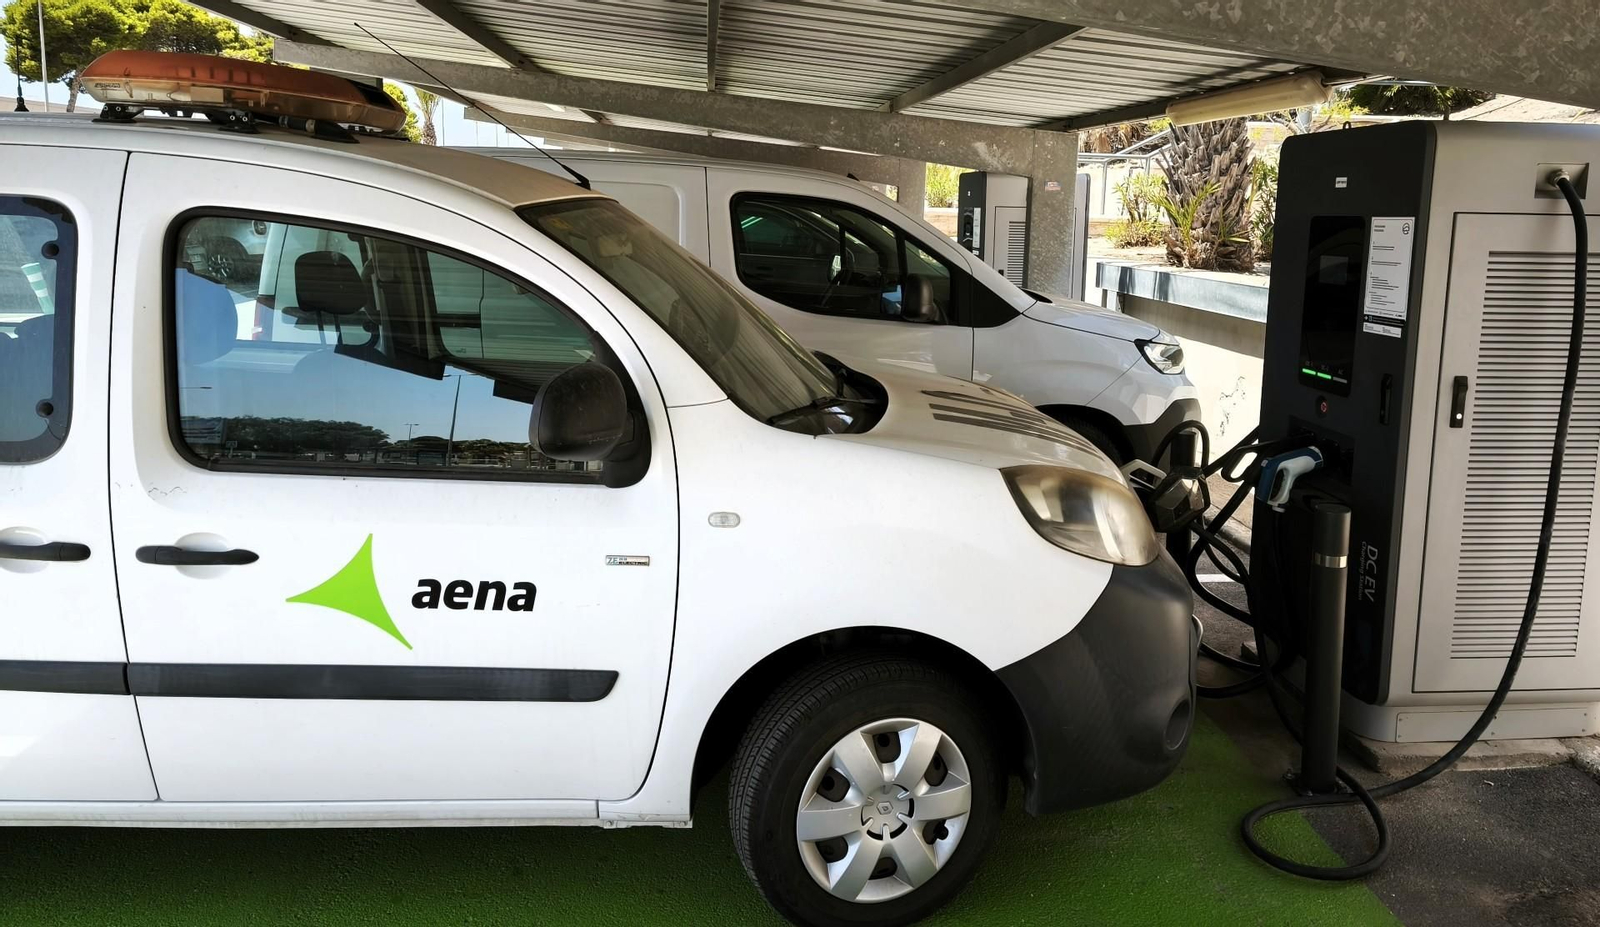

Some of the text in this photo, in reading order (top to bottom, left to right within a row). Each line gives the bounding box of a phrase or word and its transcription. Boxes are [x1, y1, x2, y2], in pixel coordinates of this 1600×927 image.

[412, 578, 537, 611] aena
[1364, 545, 1378, 602] DC EV
